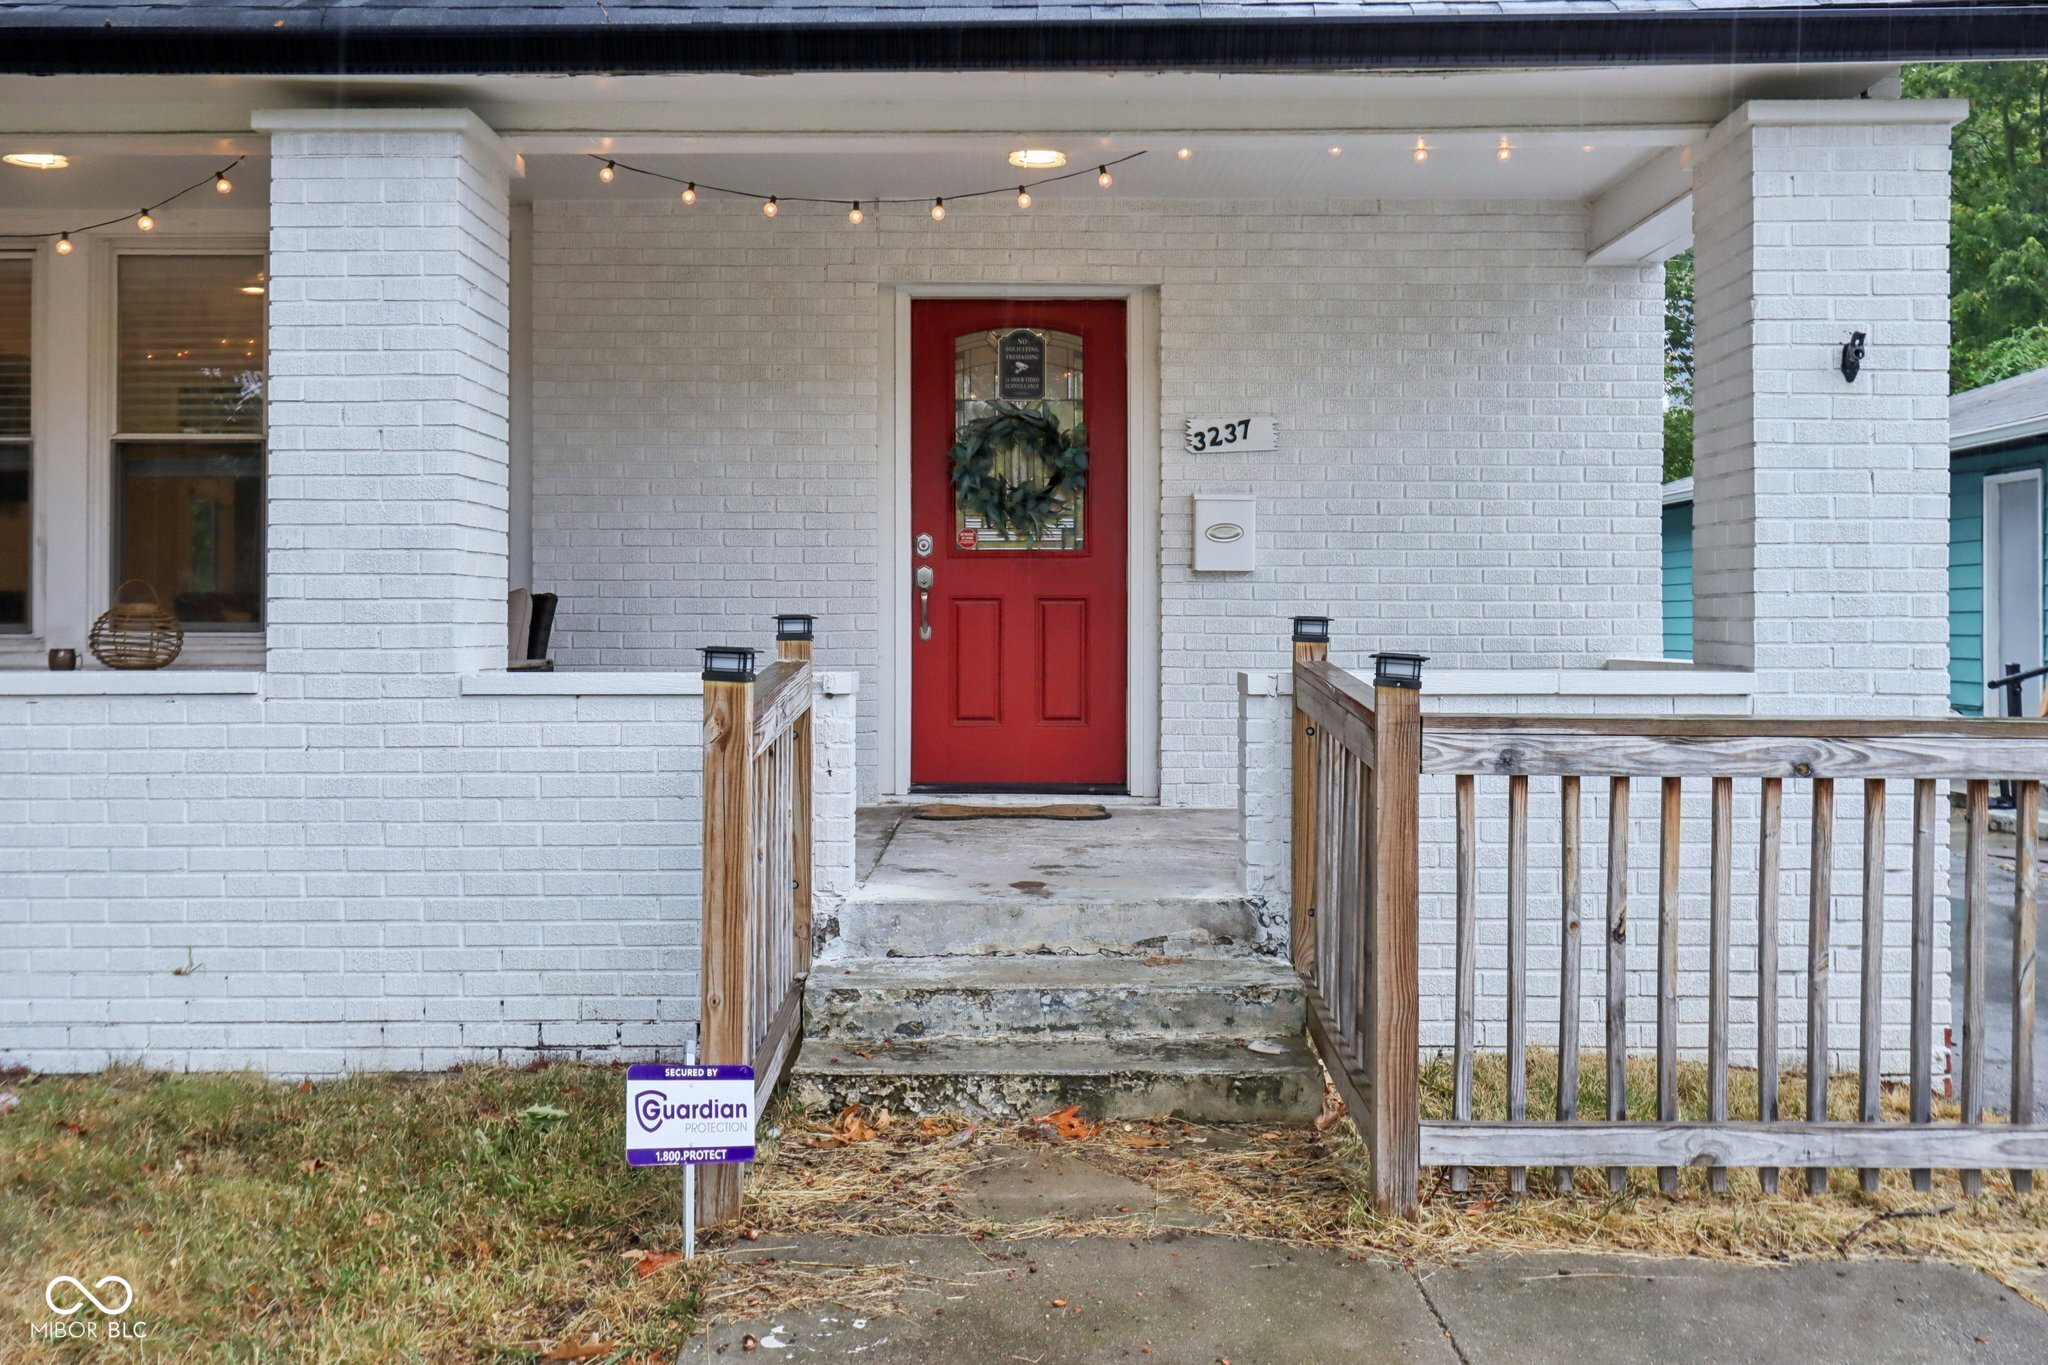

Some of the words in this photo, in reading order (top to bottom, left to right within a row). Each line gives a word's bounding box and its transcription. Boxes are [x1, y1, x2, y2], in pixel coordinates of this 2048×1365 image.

[1193, 418, 1251, 452] 3237
[664, 1068, 705, 1077] SECURED
[706, 1068, 718, 1077] BY
[642, 1099, 748, 1121] Guardian
[685, 1121, 748, 1133] PROTECTION
[655, 1149, 727, 1161] 1.800.PROTECT
